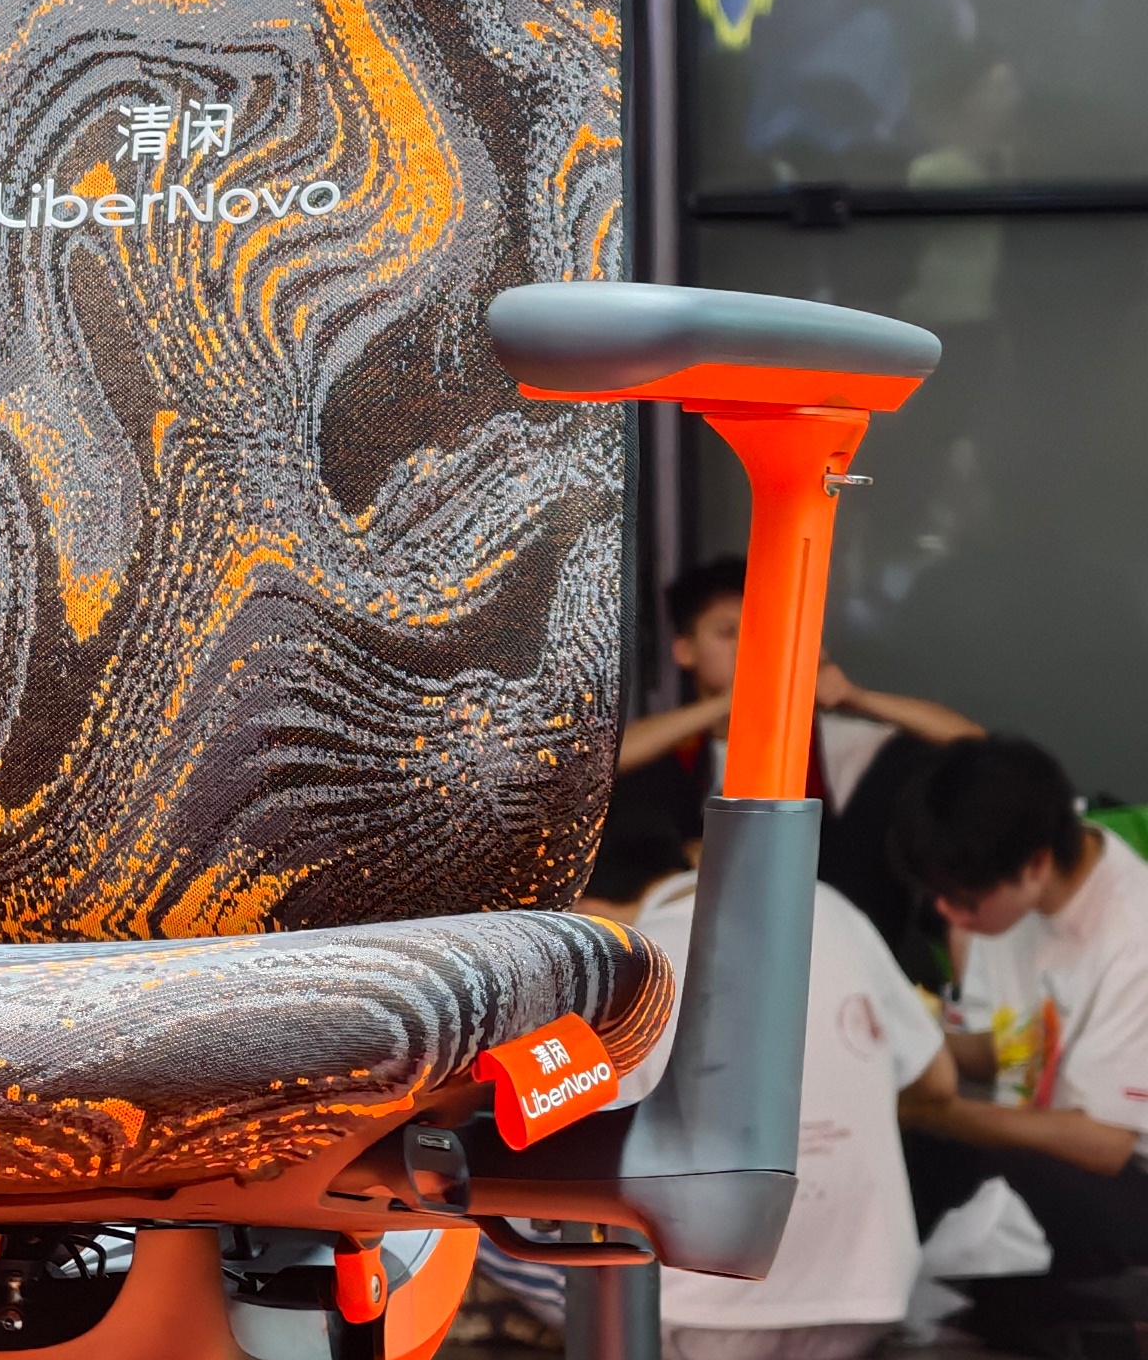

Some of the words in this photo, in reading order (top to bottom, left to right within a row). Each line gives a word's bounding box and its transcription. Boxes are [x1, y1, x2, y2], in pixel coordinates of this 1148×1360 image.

[115, 99, 235, 162] 清闲
[529, 1037, 571, 1075] 清闲
[521, 1061, 611, 1119] LiberNovo
